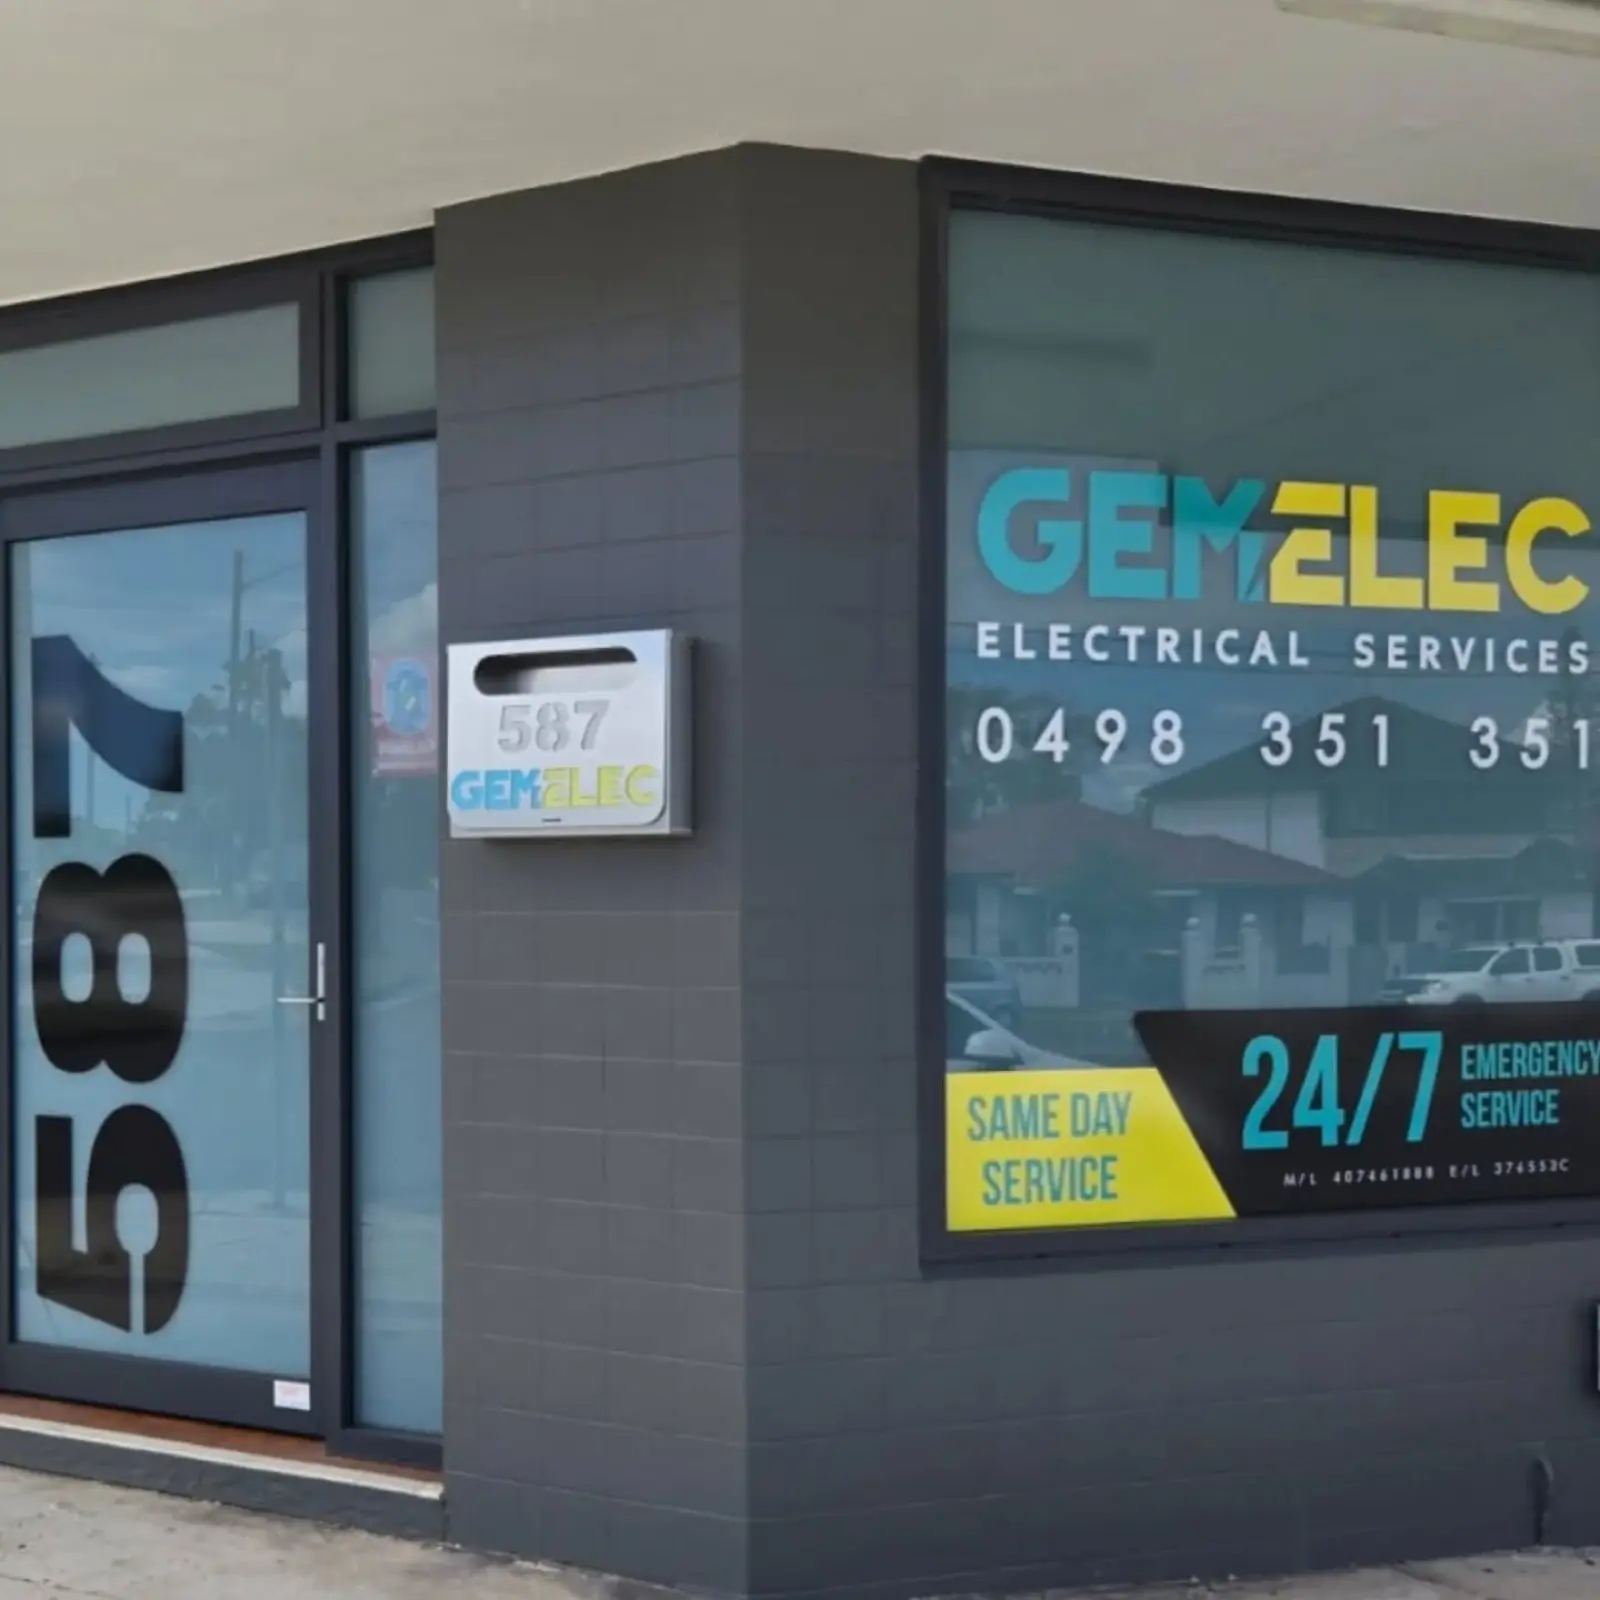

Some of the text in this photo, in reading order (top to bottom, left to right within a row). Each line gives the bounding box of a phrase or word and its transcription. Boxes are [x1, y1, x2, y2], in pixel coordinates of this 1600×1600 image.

[977, 467, 1591, 615] GEMELEC
[977, 622, 1589, 675] ELECTRICAL SERVICES
[497, 700, 610, 753] 587
[977, 707, 1589, 770] 0498 351 351
[451, 764, 661, 811] GEMELEC
[32, 633, 190, 1336] 587
[1460, 1039, 1600, 1081] EMERGENCY
[967, 1090, 1133, 1142] SAME DAY
[1241, 1030, 1443, 1149] 24/7
[1460, 1088, 1561, 1129] SERVICE
[981, 1154, 1119, 1206] SERVICE
